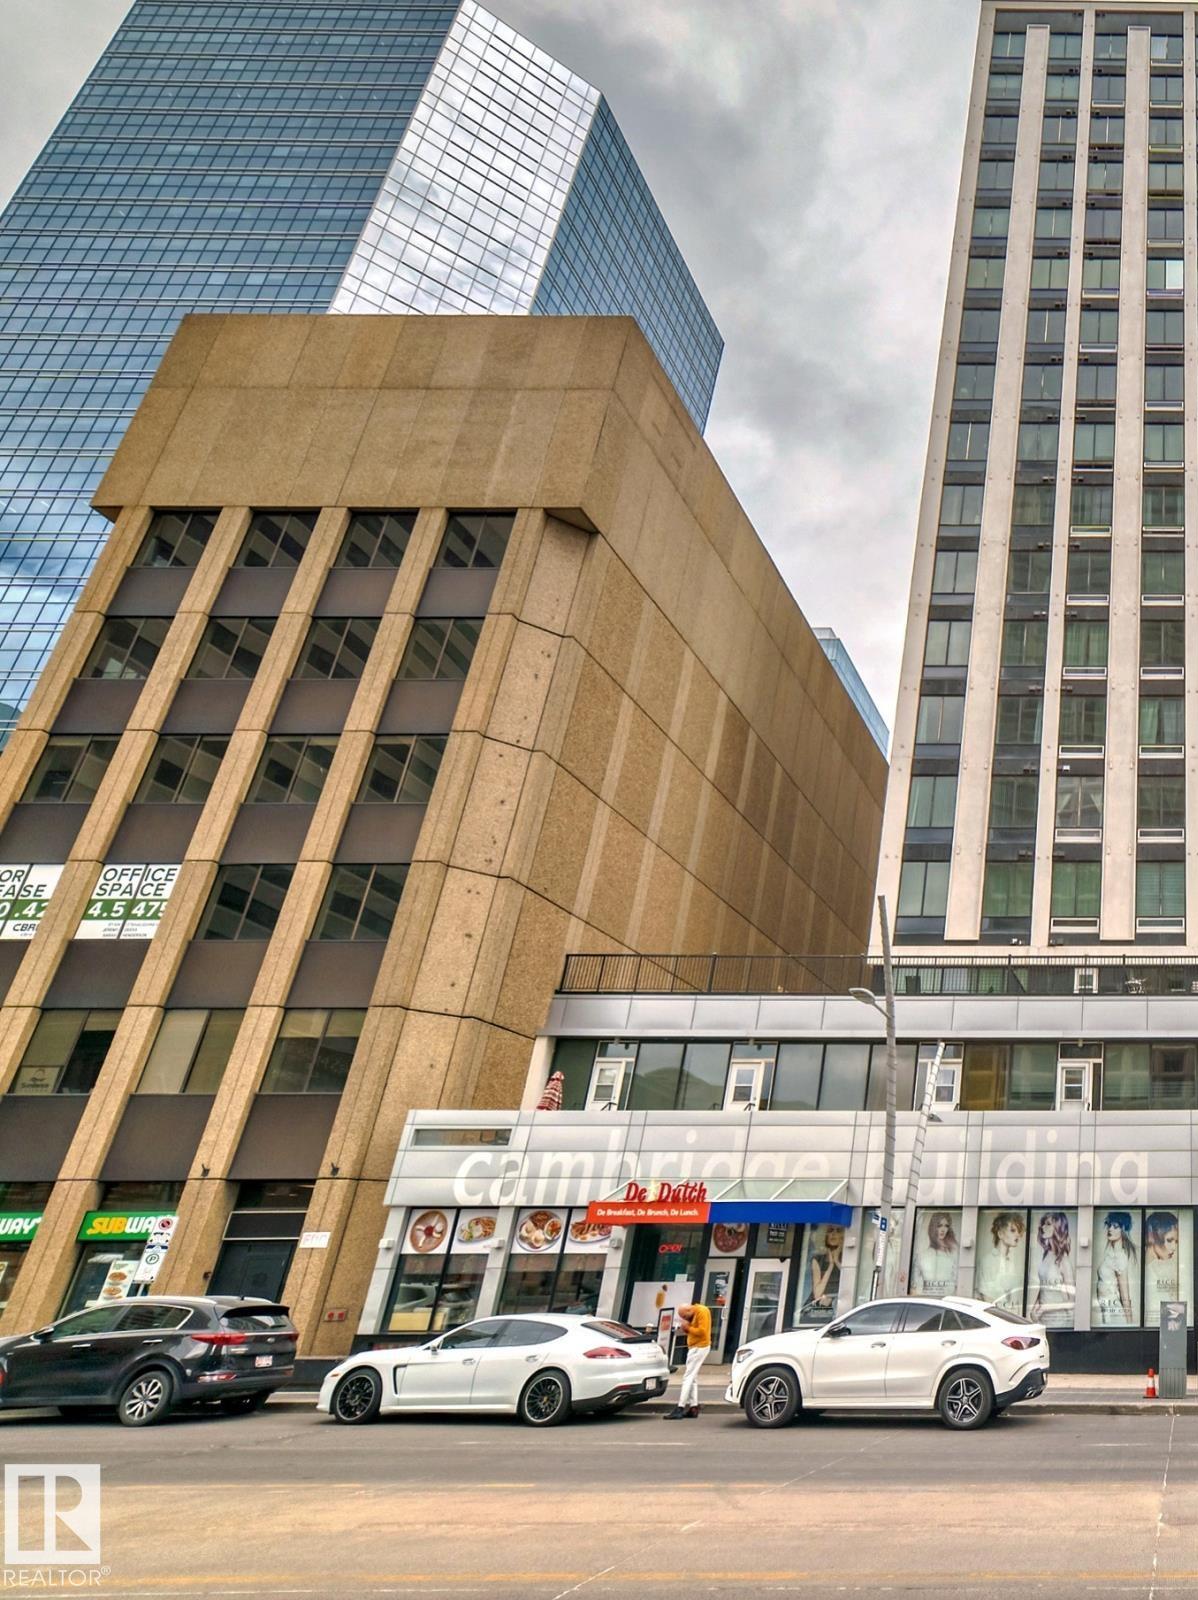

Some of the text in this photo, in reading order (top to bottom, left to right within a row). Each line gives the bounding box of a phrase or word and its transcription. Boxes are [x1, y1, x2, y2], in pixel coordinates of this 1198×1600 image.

[0, 868, 25, 882] OR
[103, 868, 178, 882] OFFICE
[95, 883, 167, 897] SPACE
[12, 923, 39, 932] CBR
[862, 1129, 1150, 1206] building
[624, 1181, 707, 1203] De Dutch
[86, 1217, 158, 1235] SUBWA
